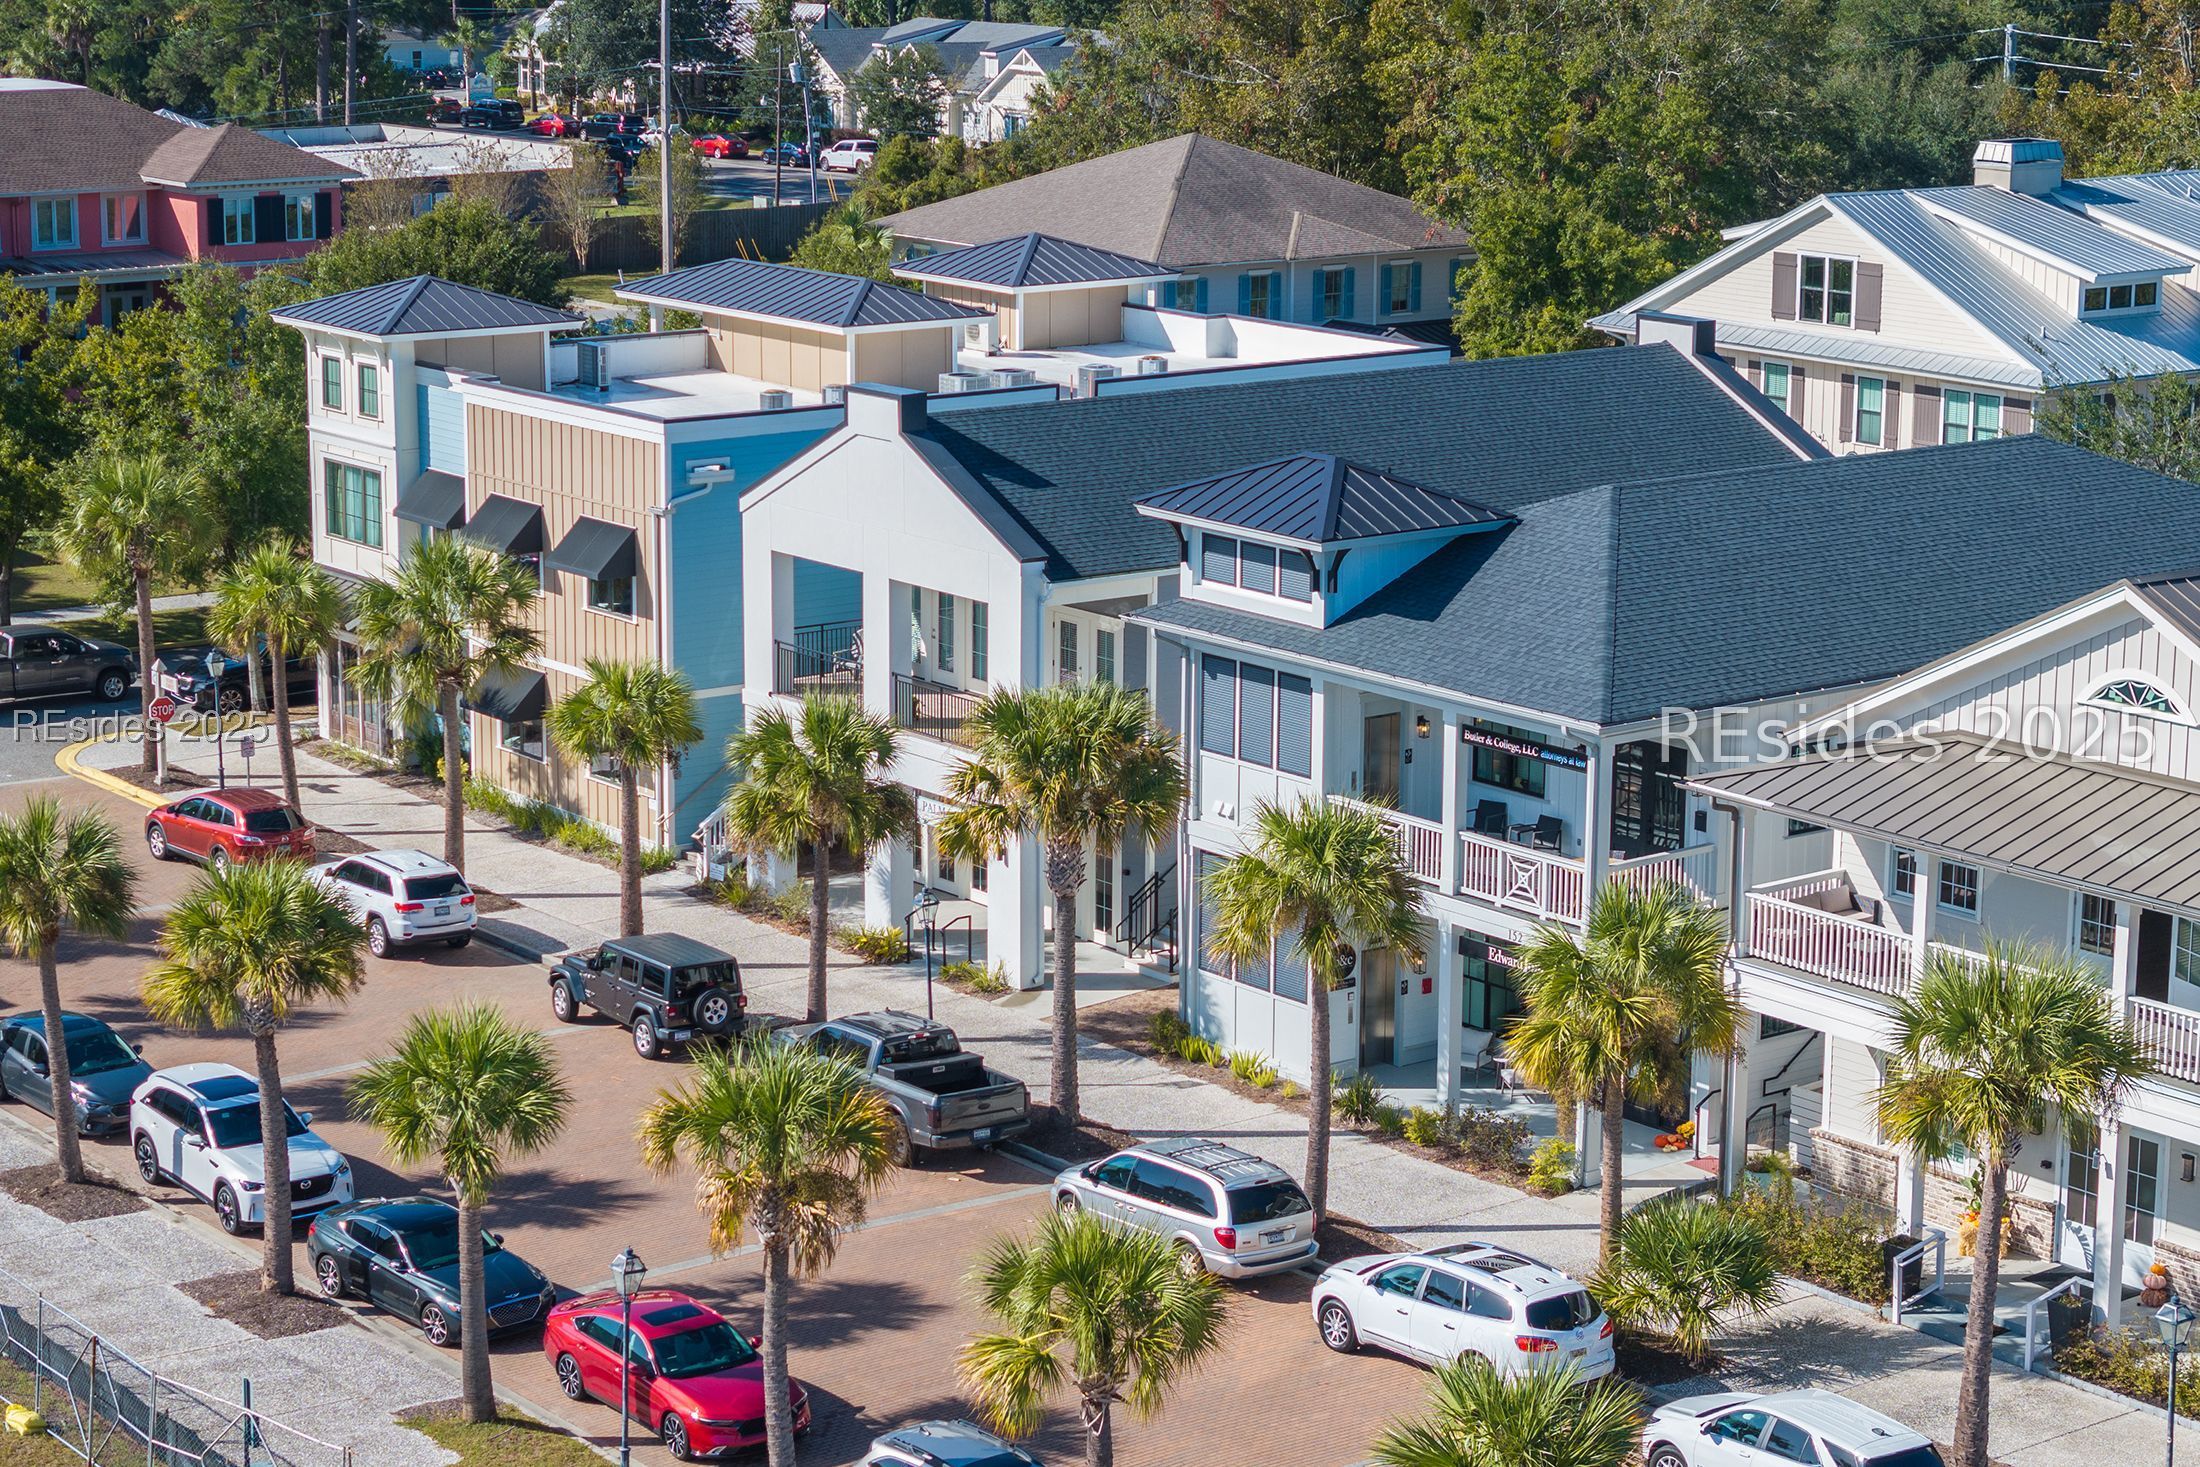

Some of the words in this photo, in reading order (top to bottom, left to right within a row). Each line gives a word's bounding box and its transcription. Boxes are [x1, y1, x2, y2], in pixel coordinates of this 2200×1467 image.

[151, 704, 174, 718] STOP
[1486, 735, 1493, 745] &
[1522, 743, 1539, 757] LLC
[1508, 929, 1523, 942] 152
